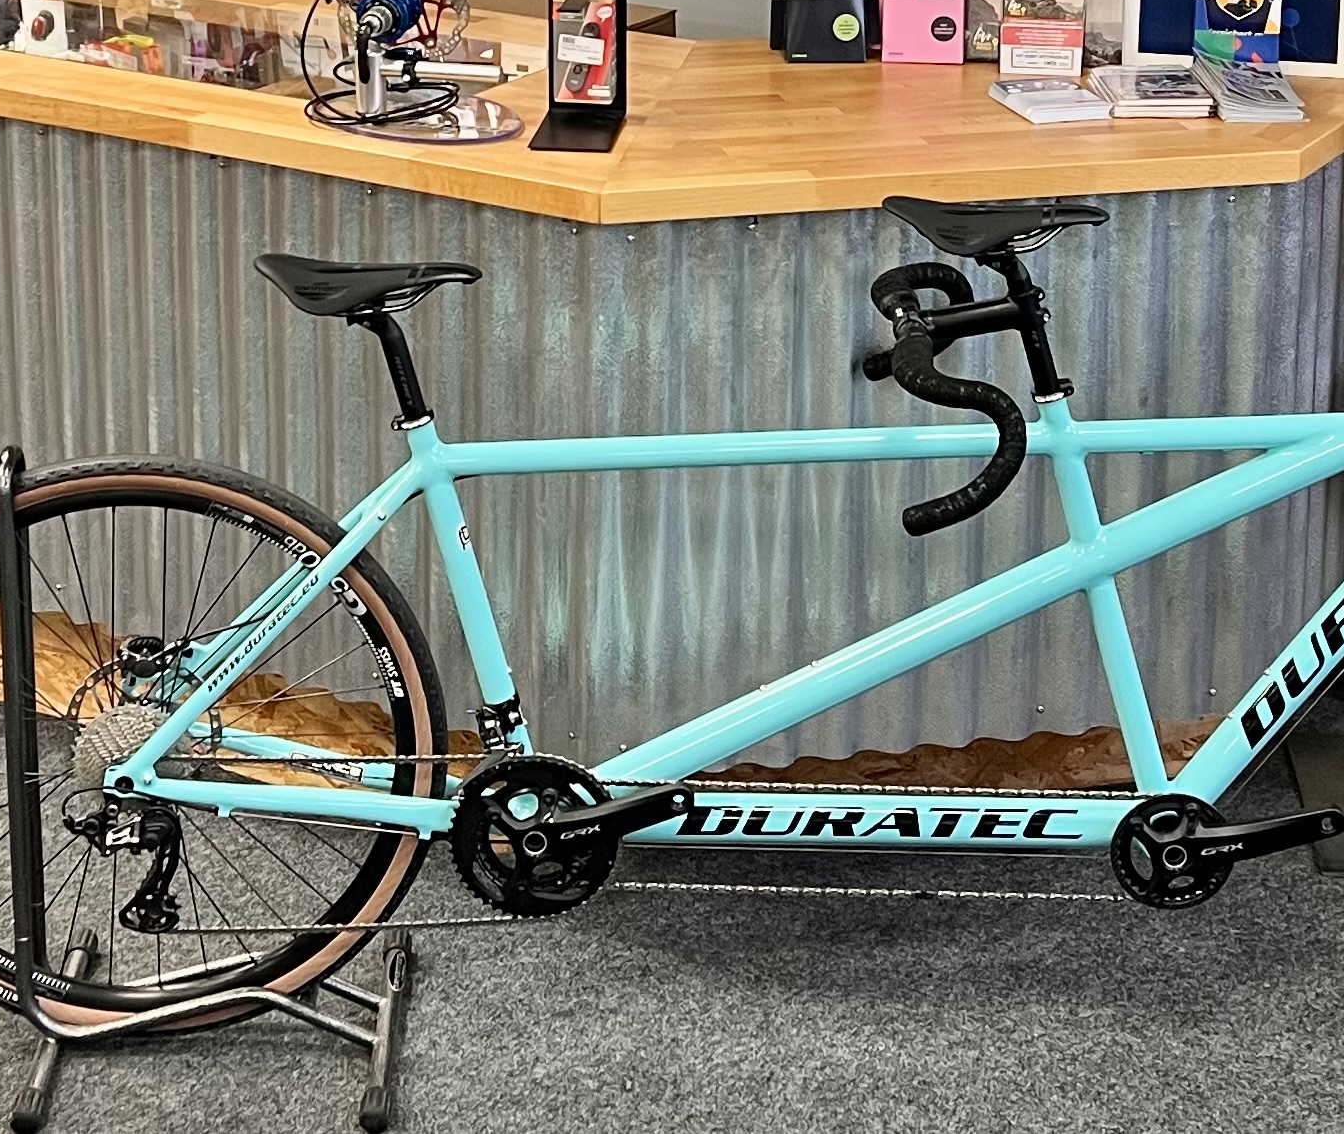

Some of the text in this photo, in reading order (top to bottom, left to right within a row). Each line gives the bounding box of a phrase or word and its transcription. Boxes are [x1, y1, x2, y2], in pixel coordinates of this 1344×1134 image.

[207, 572, 320, 694] www.duratec.eu
[378, 646, 399, 679] SWISS
[560, 823, 602, 841] GRX
[676, 806, 1084, 841] DURATEC
[1200, 841, 1245, 857] GRX
